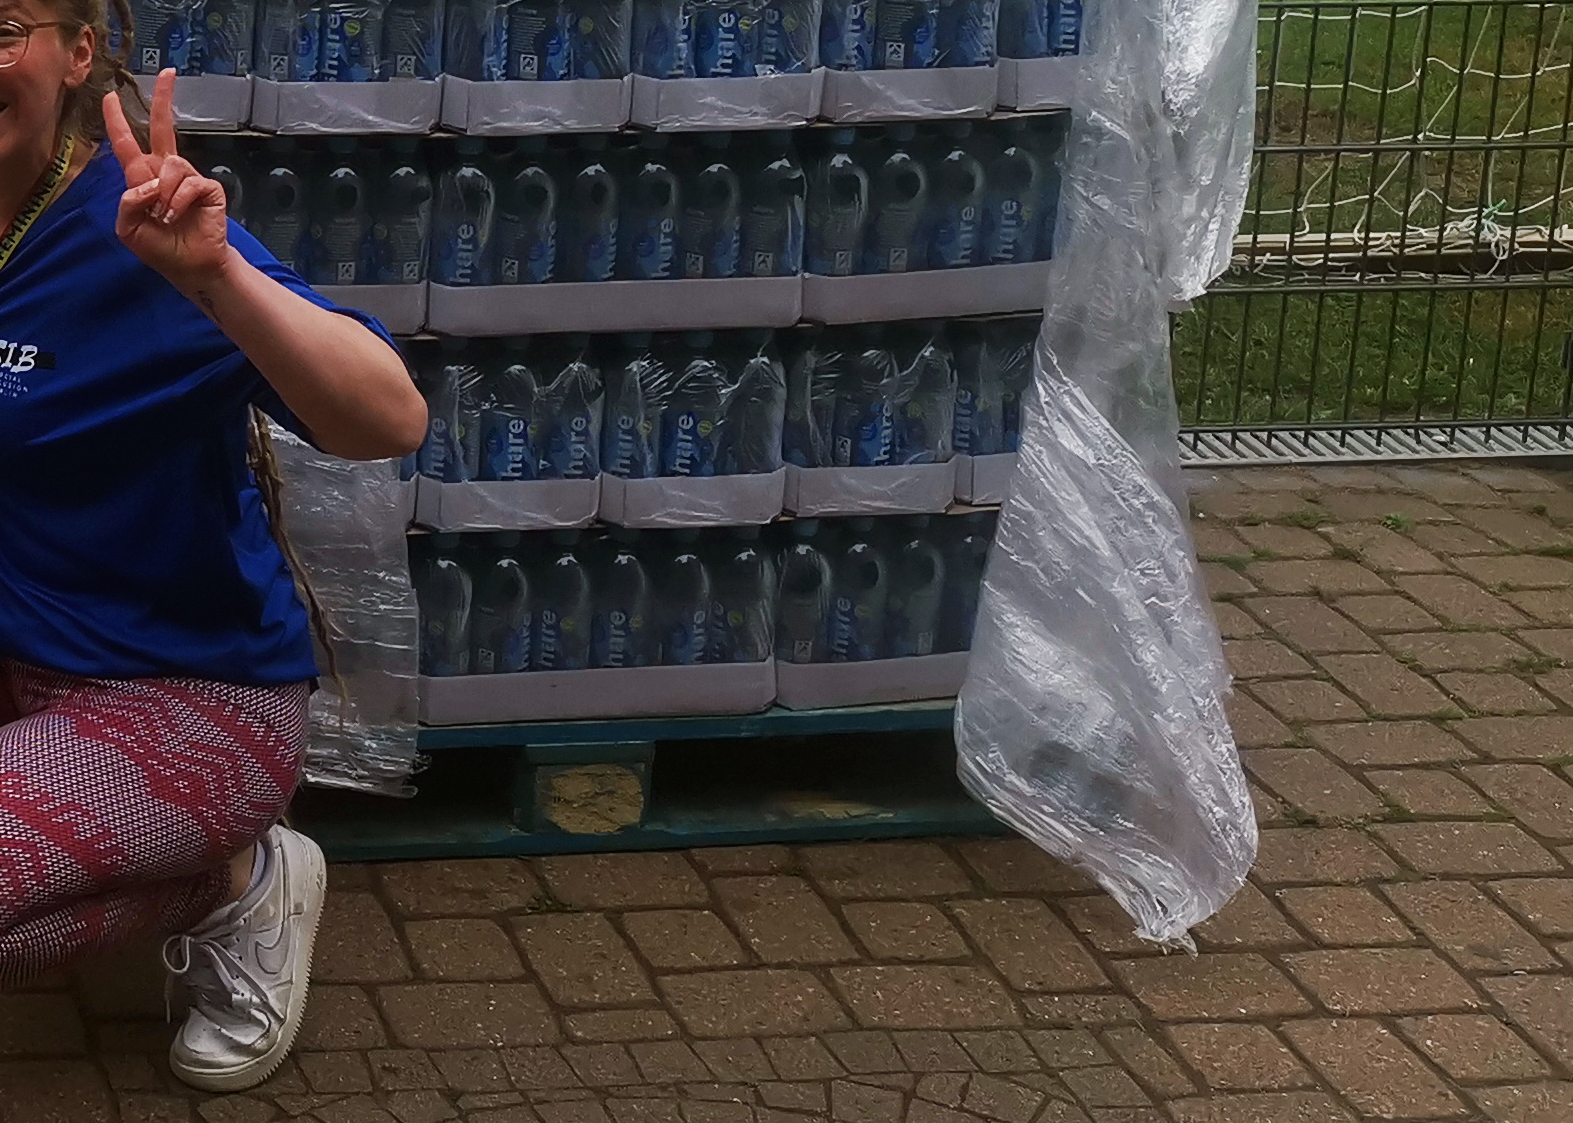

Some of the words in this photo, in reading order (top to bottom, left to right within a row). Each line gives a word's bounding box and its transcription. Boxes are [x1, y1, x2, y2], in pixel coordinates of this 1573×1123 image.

[325, 11, 340, 79] hare
[711, 11, 735, 77] hare
[450, 224, 474, 282] hare
[656, 217, 674, 277] hare
[949, 205, 974, 263] hare
[994, 199, 1018, 262] hare
[427, 417, 446, 477] hare
[501, 418, 524, 477] hare
[564, 416, 586, 477] hare
[671, 414, 693, 477] hare
[602, 610, 625, 666] hare
